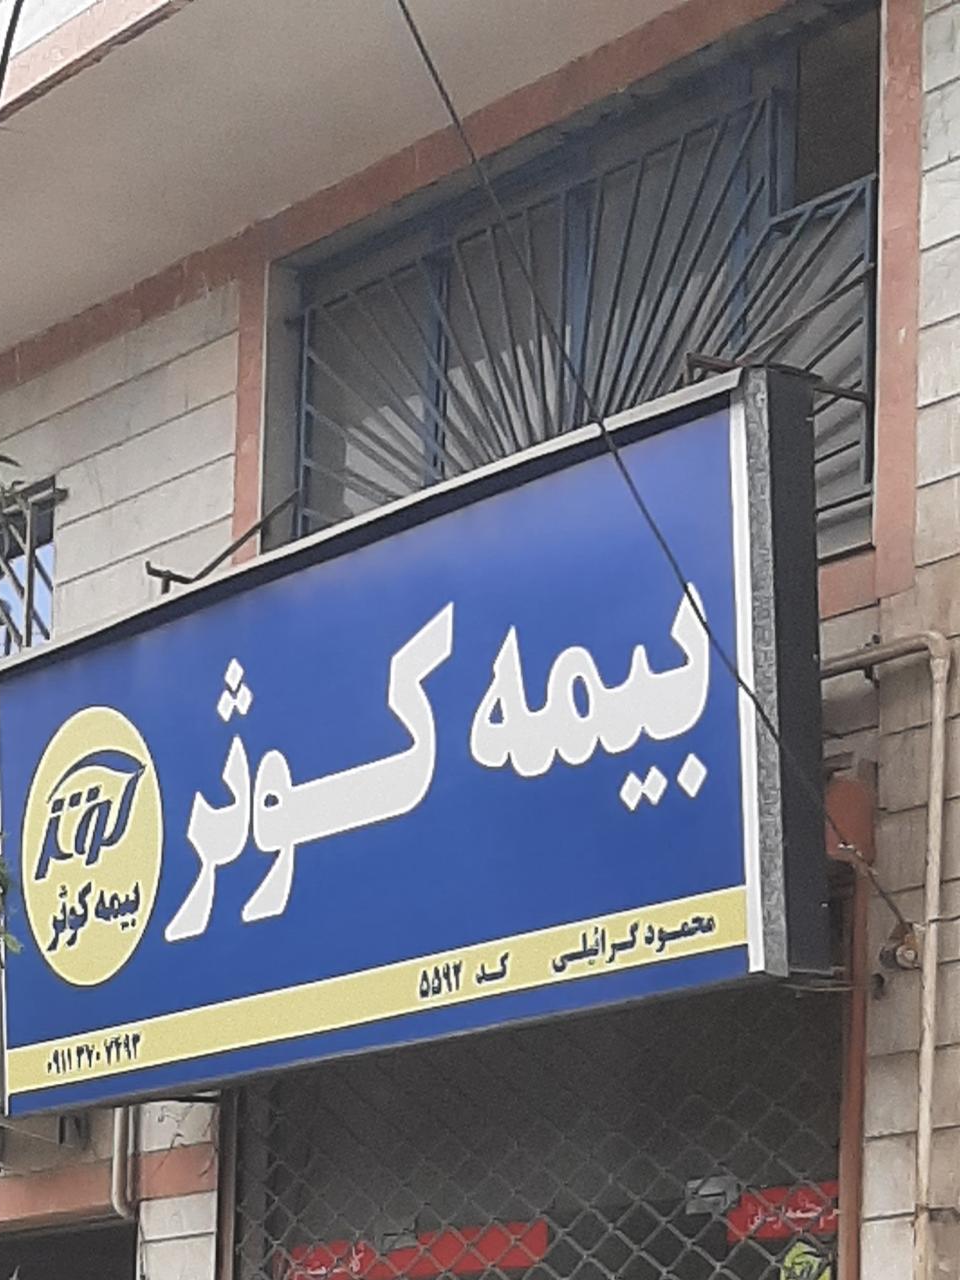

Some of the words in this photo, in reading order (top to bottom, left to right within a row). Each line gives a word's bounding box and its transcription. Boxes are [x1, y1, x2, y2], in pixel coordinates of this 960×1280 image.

[470, 582, 711, 811] بیمه
[164, 601, 454, 942] کوثر
[46, 880, 93, 952] کوثر
[94, 881, 142, 931] بیمه
[644, 914, 717, 953] محمود
[475, 952, 509, 985] کد
